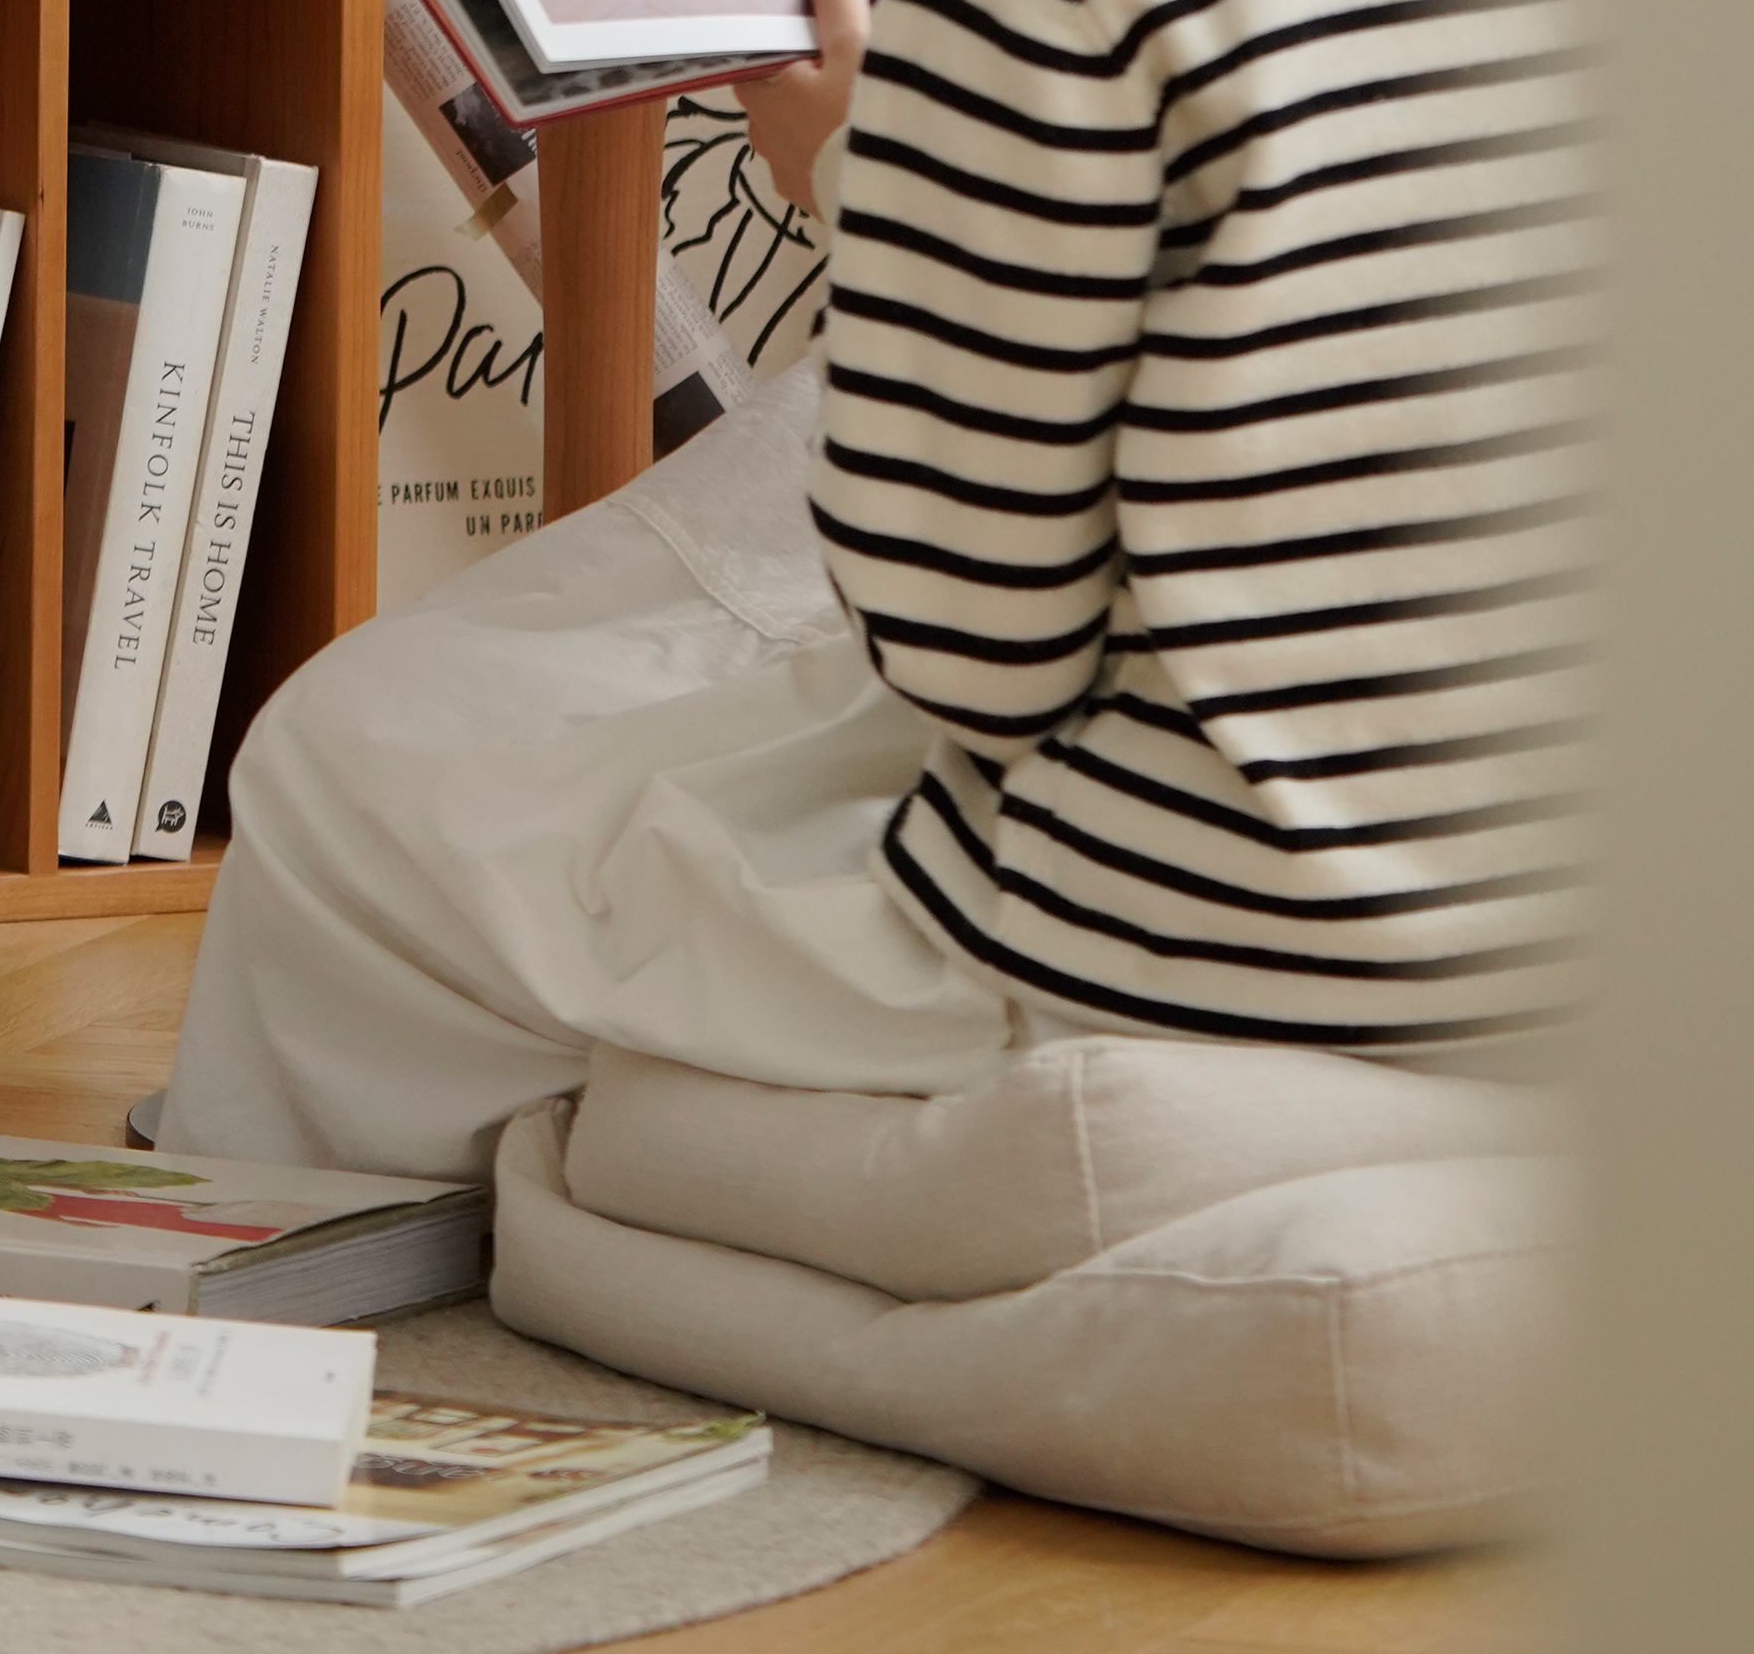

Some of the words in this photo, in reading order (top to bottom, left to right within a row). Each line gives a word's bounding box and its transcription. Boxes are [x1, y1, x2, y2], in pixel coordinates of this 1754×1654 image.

[181, 220, 215, 232] BURNS
[186, 207, 214, 218] JOHN
[261, 244, 280, 303] NATALIE
[251, 307, 269, 364] WALTON
[138, 361, 186, 524] KINFOLK
[220, 411, 256, 492] THIS
[214, 499, 240, 531] IS
[391, 480, 459, 505] PARFUM
[471, 477, 536, 501] EXQUIS
[465, 513, 490, 536] UN
[113, 540, 156, 671] TRAVEL
[192, 539, 233, 646] HOME
